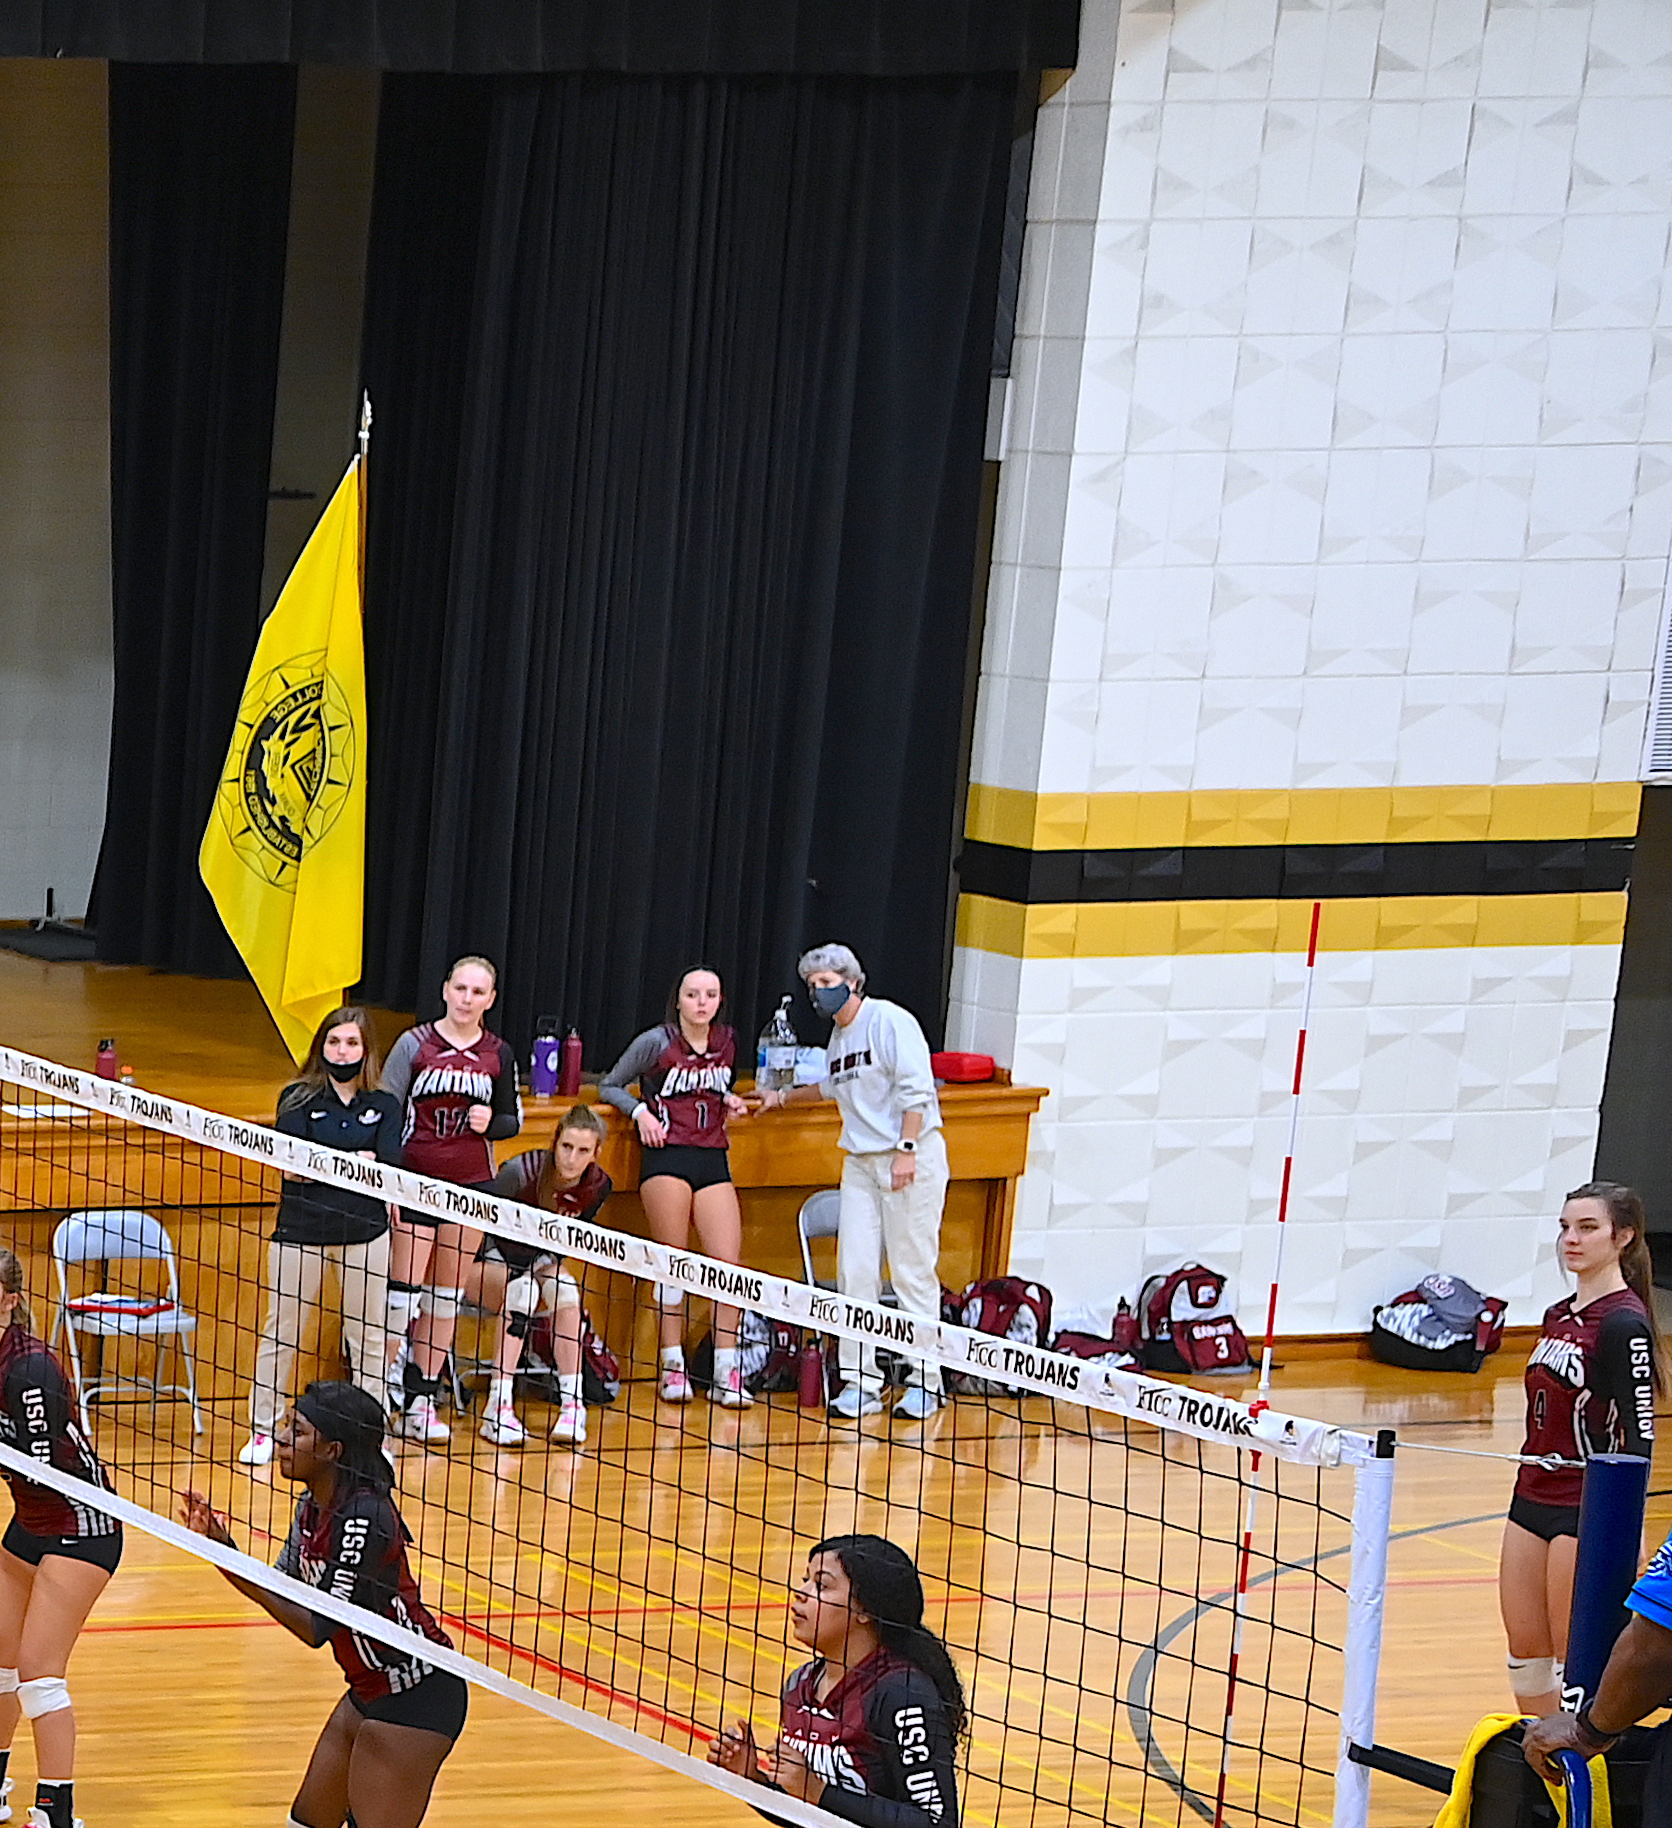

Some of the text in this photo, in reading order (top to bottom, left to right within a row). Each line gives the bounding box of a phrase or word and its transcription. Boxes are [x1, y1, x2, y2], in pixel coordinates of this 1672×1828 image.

[40, 1063, 79, 1095] TROJANS
[412, 1067, 493, 1101] BANTAMS
[661, 1064, 732, 1098] BANTAMS
[130, 1094, 173, 1124] TROJANS
[694, 1100, 708, 1129] 1
[228, 1126, 274, 1156] TROJANS
[332, 1156, 384, 1189] TROJANS
[445, 1189, 499, 1225] TROJANS
[566, 1225, 626, 1262] TROJANS
[668, 1254, 763, 1302] FTCC TROJANS
[809, 1294, 915, 1345] FTCC TROJANS
[966, 1336, 1080, 1390] FTCC TROJANS
[1215, 1336, 1229, 1359] 3
[1629, 1337, 1651, 1379] USC
[22, 1387, 48, 1434] USC
[1136, 1384, 1172, 1417] FTCC
[340, 1518, 370, 1564] USC
[895, 1707, 930, 1766] USC
